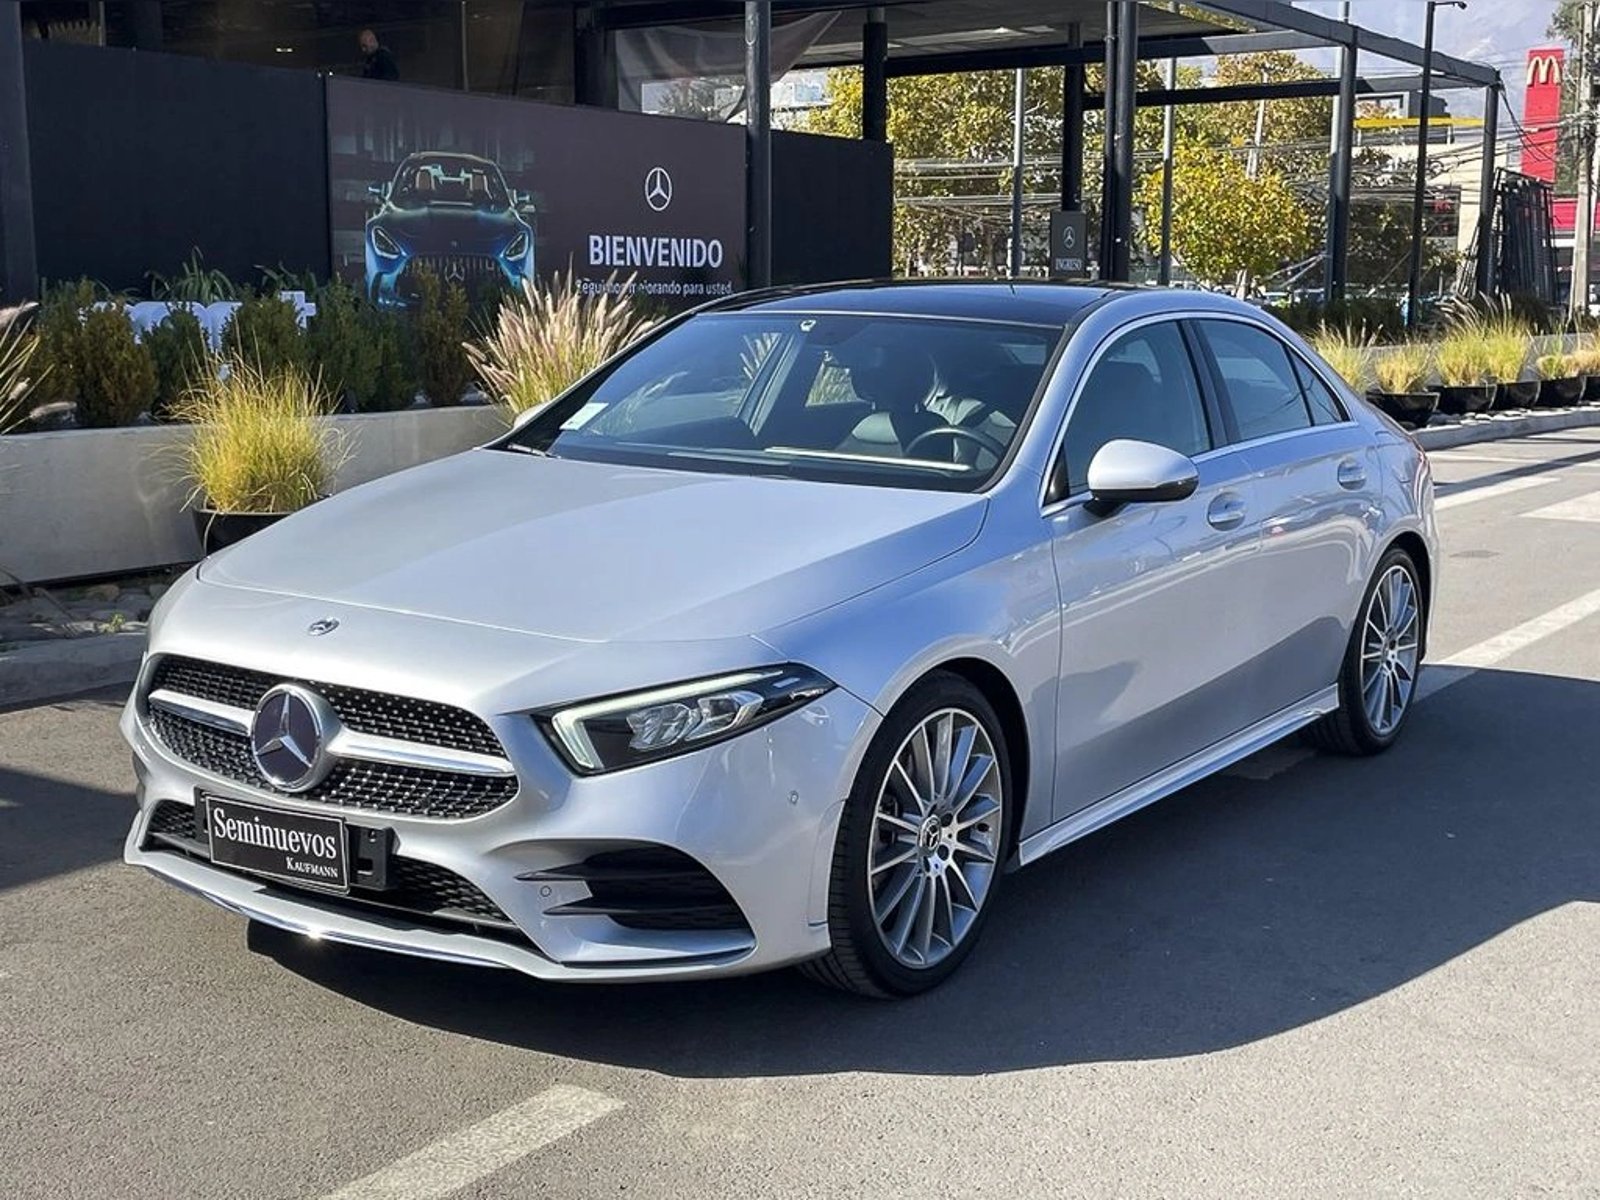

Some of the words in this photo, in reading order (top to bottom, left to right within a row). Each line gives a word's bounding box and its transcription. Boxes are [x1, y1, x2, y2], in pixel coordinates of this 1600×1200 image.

[589, 234, 723, 268] BIENVENIDO
[683, 283, 704, 298] para
[213, 807, 337, 859] Seminuevos
[286, 856, 339, 878] KAUFMANN
